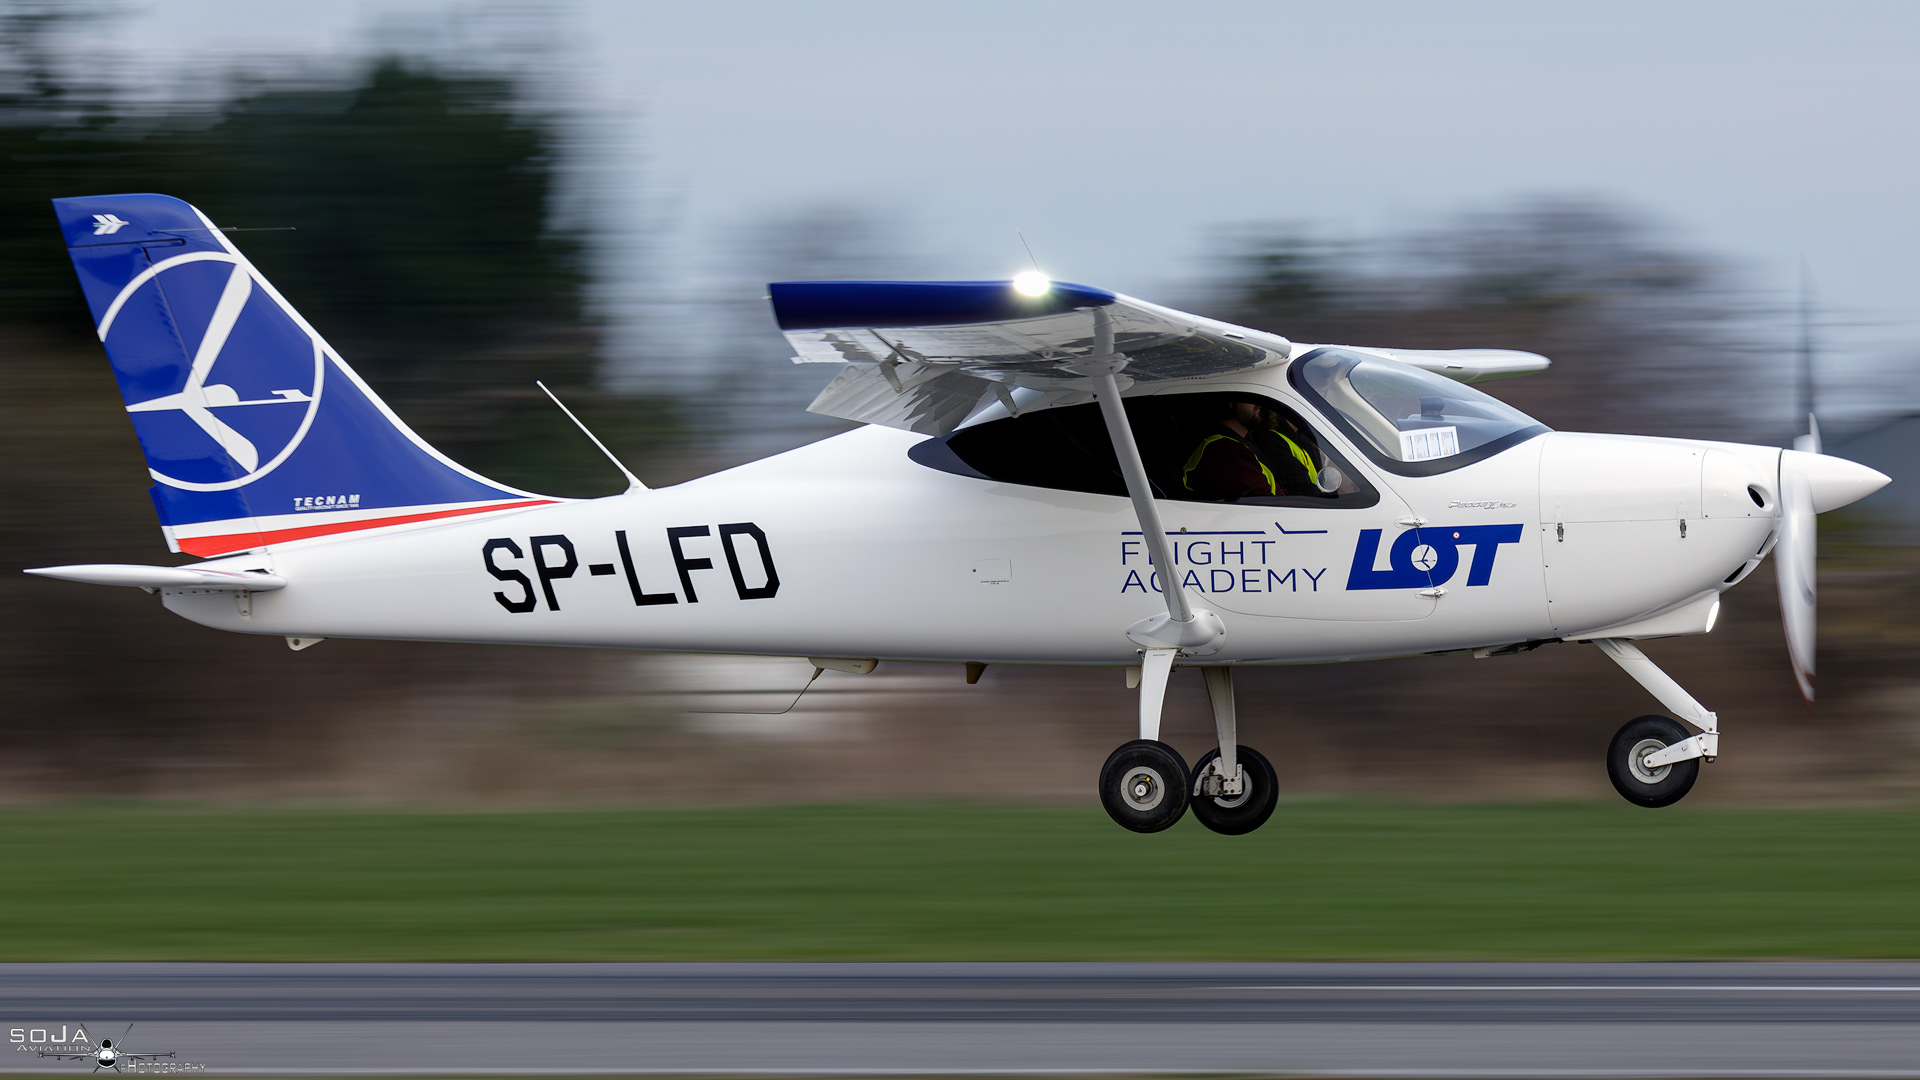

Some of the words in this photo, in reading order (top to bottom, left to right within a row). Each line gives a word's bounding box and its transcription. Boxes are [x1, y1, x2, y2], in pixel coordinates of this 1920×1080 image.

[293, 494, 361, 507] TECNAM
[482, 521, 781, 613] SP-LFD
[1121, 541, 1276, 565] FIGHT
[1345, 523, 1524, 591] LOT
